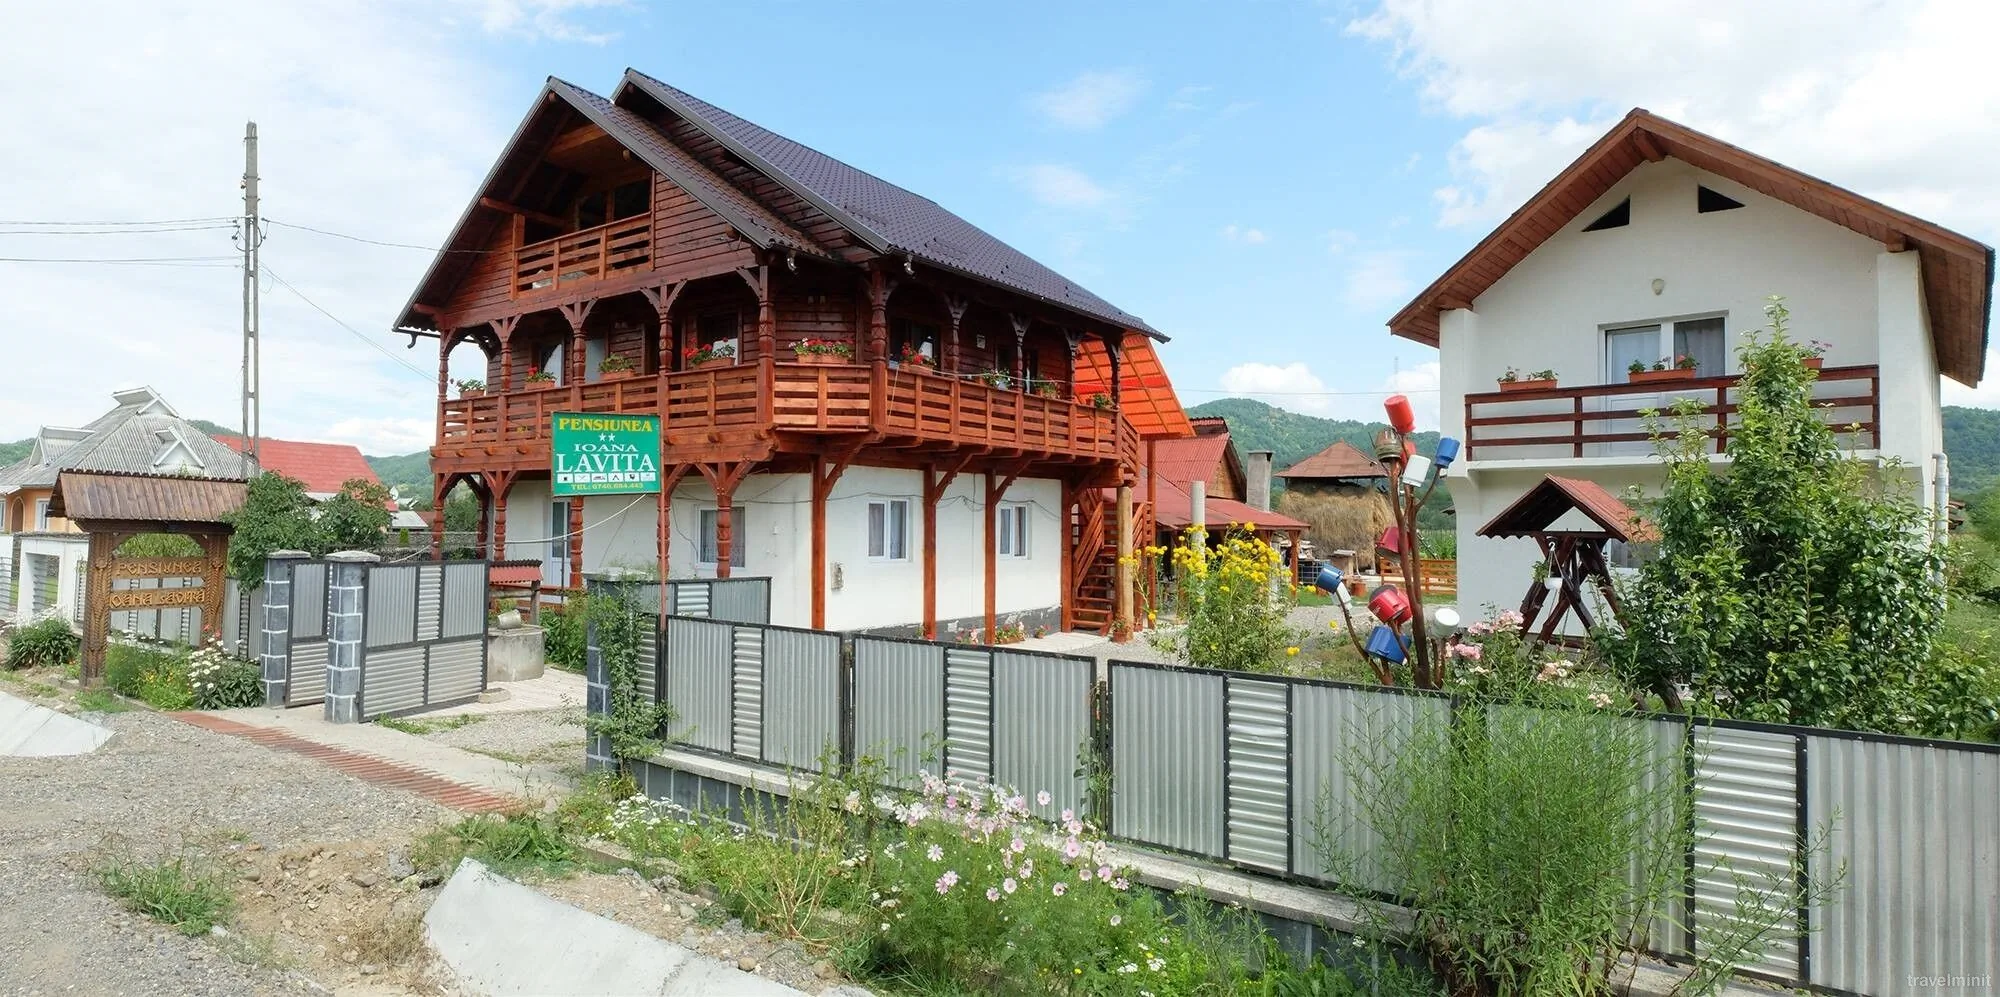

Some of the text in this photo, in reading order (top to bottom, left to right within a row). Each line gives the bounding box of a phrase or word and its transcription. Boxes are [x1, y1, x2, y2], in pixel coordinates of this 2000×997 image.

[559, 417, 653, 432] PENSIUNEA
[574, 443, 639, 452] IOANA
[556, 453, 657, 473] LAVITA
[116, 560, 202, 576] PENSIUNEA
